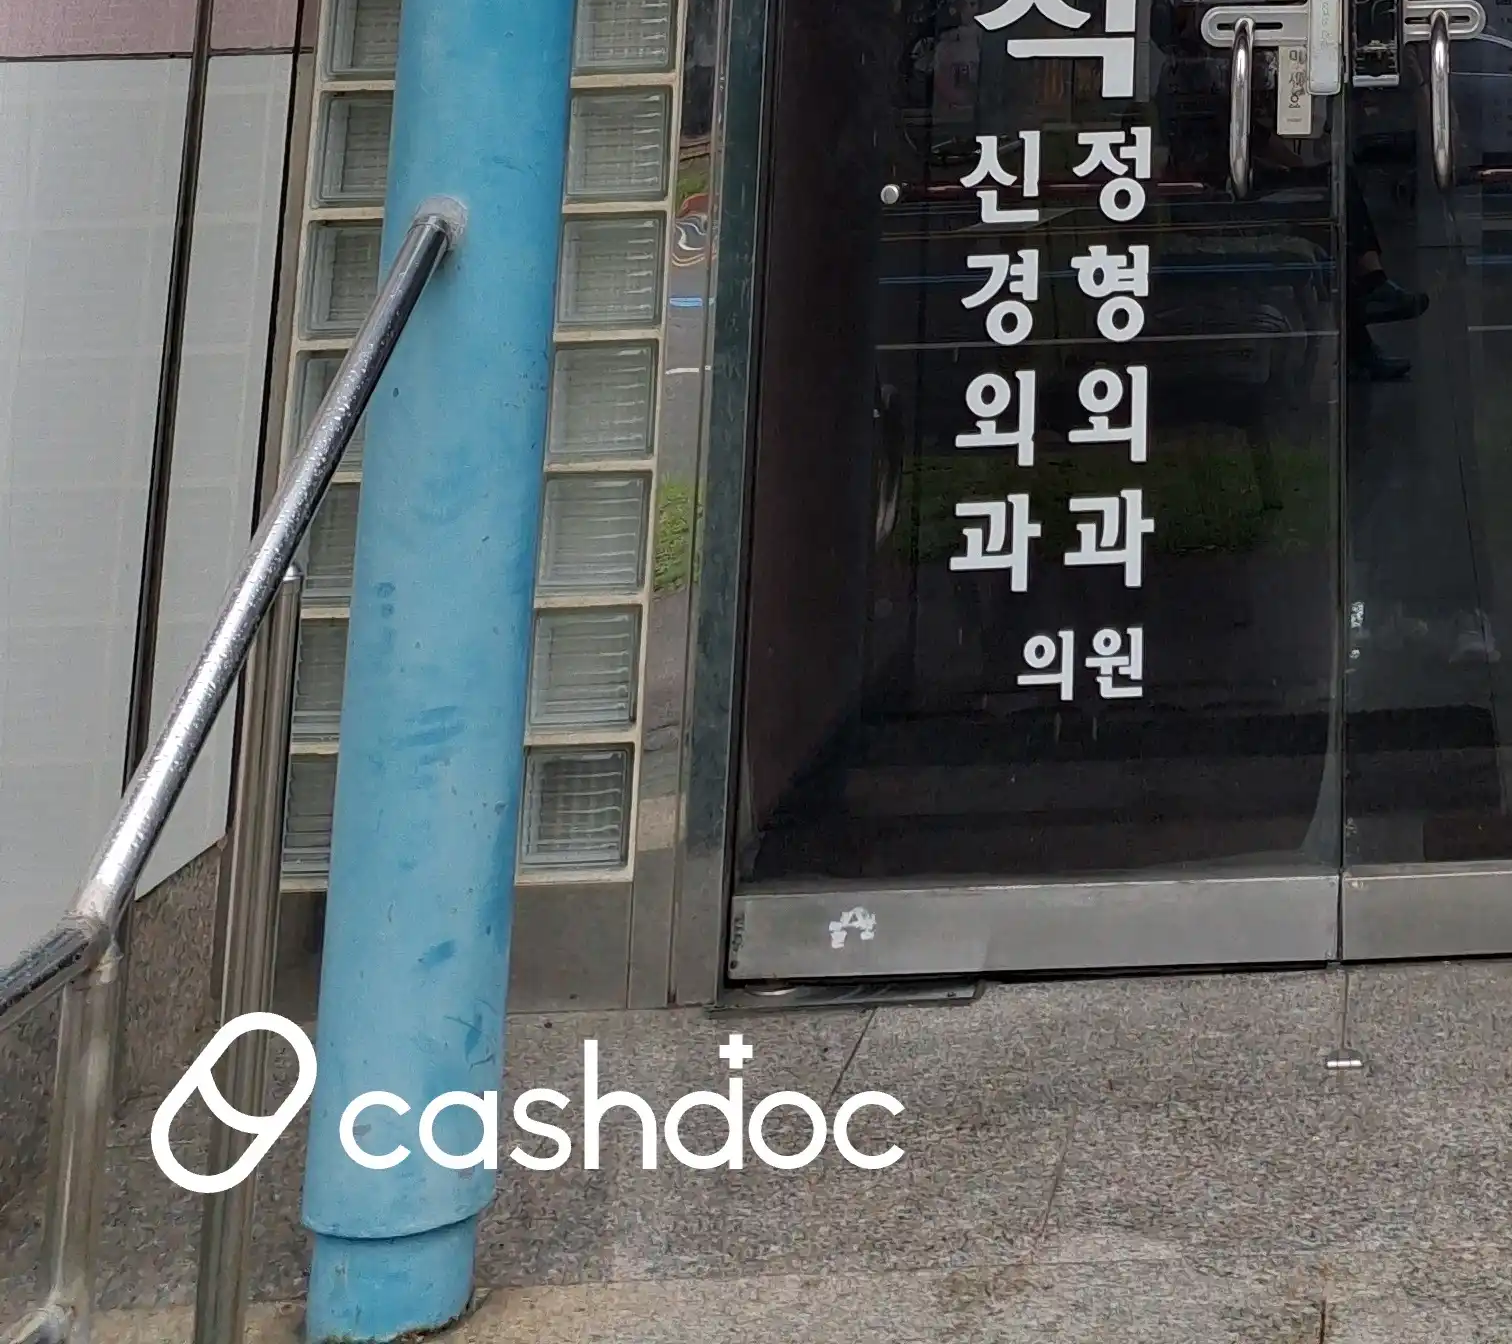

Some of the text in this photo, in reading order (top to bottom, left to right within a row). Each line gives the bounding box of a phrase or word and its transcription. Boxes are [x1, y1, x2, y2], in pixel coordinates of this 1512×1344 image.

[949, 130, 1042, 592] 신경외과
[1063, 126, 1155, 588] 정형외과
[1017, 627, 1144, 701] 의원
